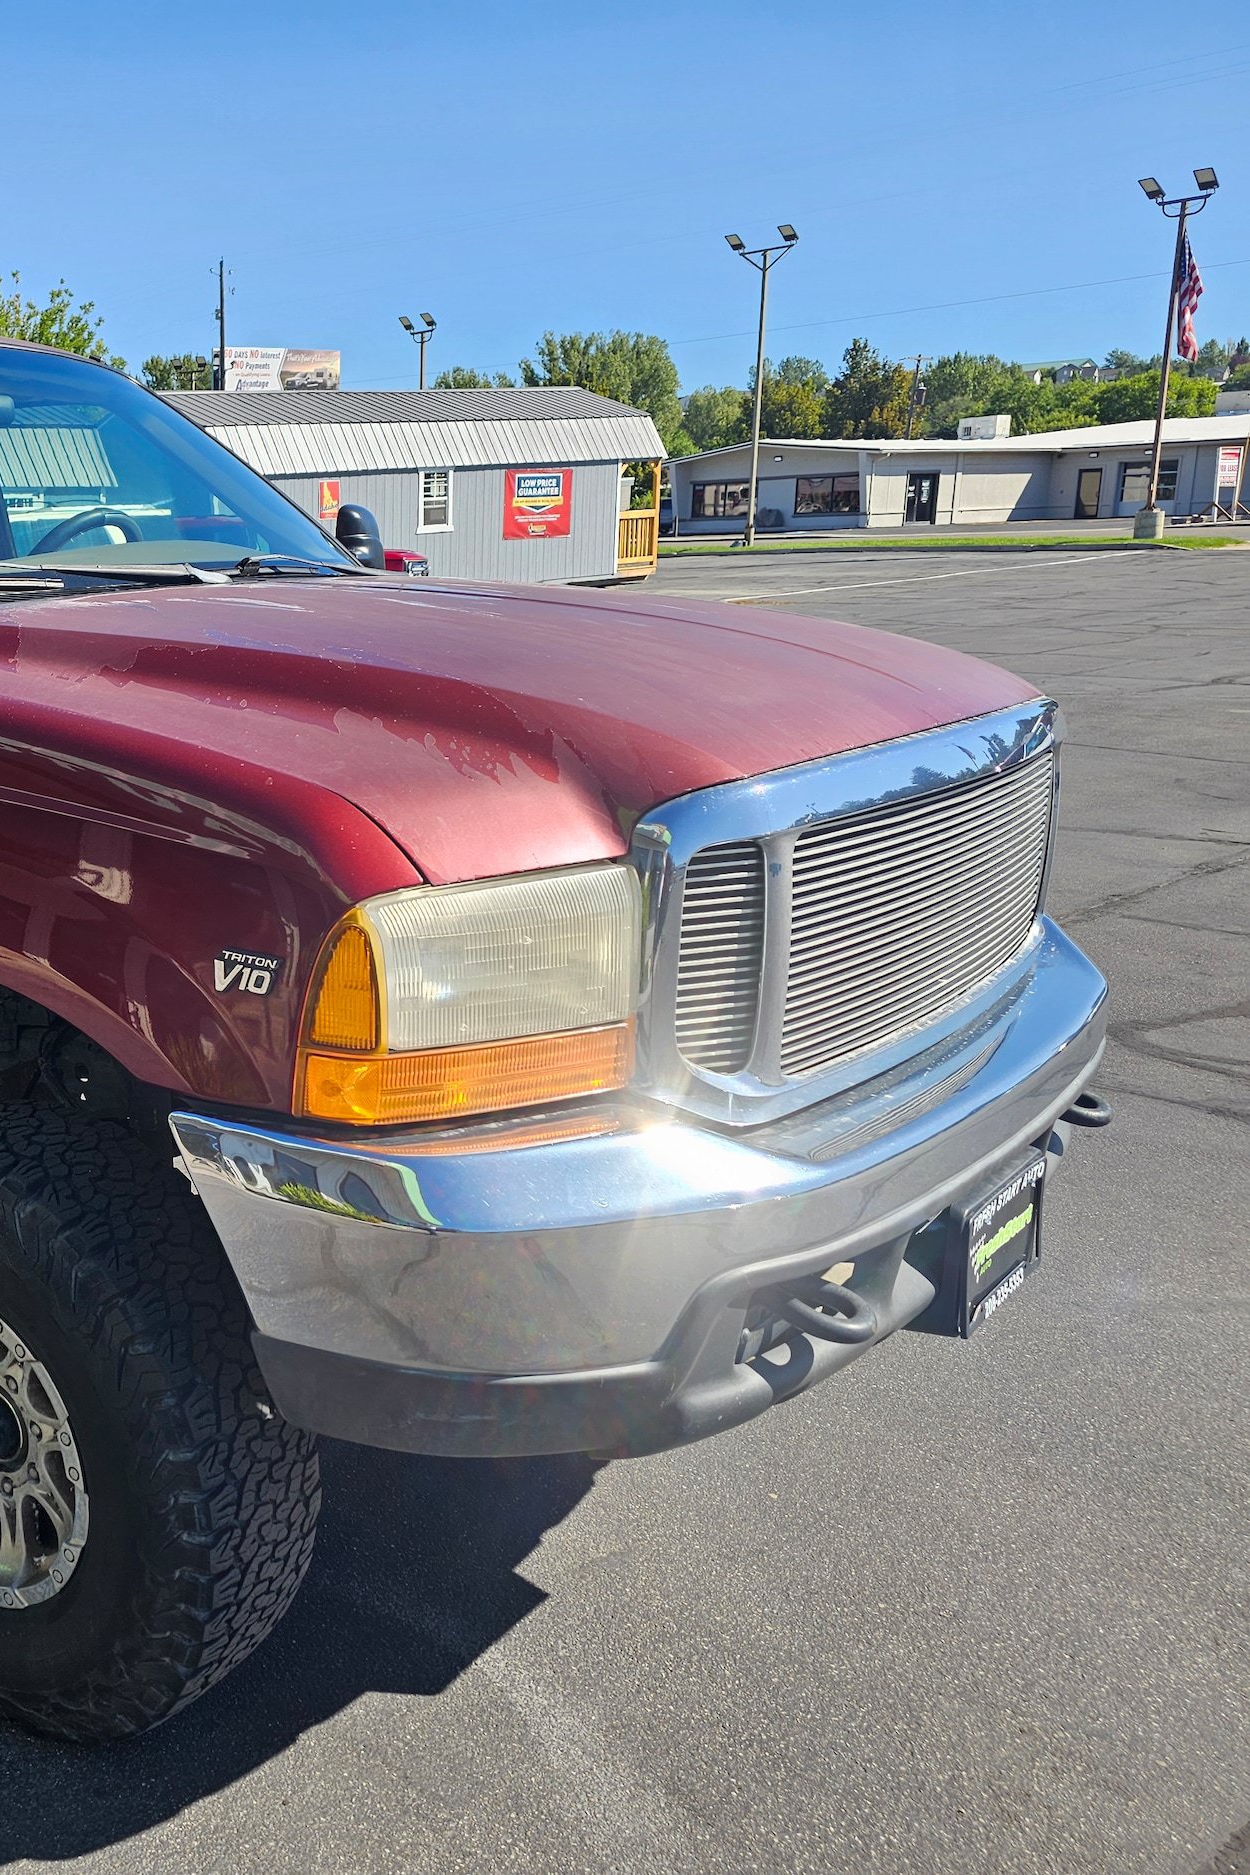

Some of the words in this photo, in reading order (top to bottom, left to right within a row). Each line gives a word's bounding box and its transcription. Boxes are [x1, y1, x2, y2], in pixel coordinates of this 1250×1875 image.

[234, 351, 248, 359] DAYS
[249, 350, 259, 359] NO
[260, 351, 281, 360] Interest
[234, 361, 244, 369] NO
[245, 362, 270, 371] Payments
[236, 379, 270, 391] Advantage
[537, 479, 557, 487] PRICE
[518, 487, 559, 496] GUARANTEE
[222, 950, 278, 969] TRITON
[213, 959, 271, 995] V10
[996, 1178, 1022, 1211] START
[1020, 1162, 1045, 1191] AUTO
